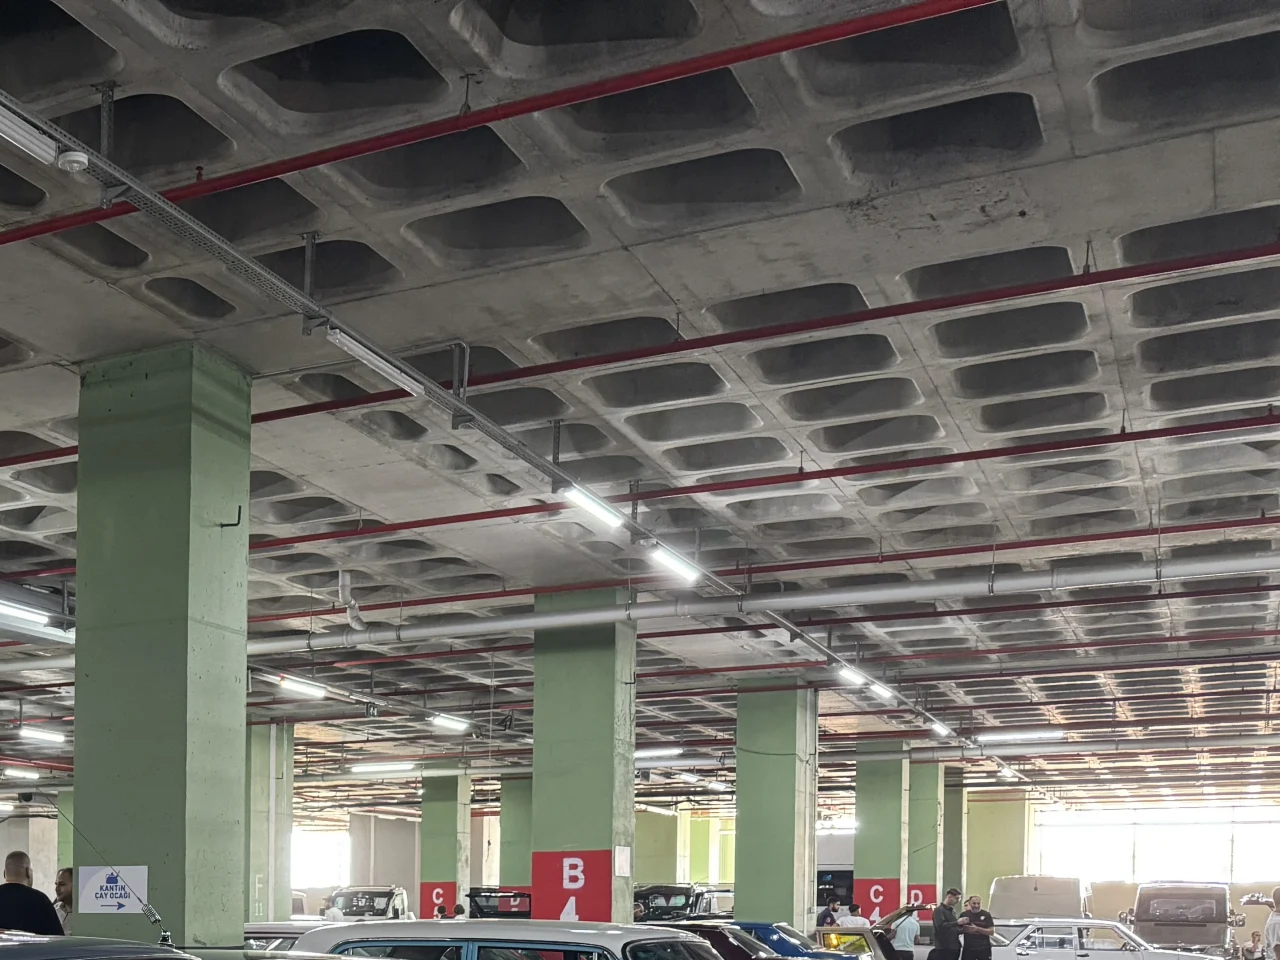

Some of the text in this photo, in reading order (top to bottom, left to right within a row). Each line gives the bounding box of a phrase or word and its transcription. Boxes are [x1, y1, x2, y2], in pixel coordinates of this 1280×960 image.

[563, 858, 585, 889] B
[94, 891, 131, 900] ÇAY OCAĞI
[99, 884, 126, 892] KANTİN
[432, 888, 444, 904] C
[870, 885, 884, 903] C
